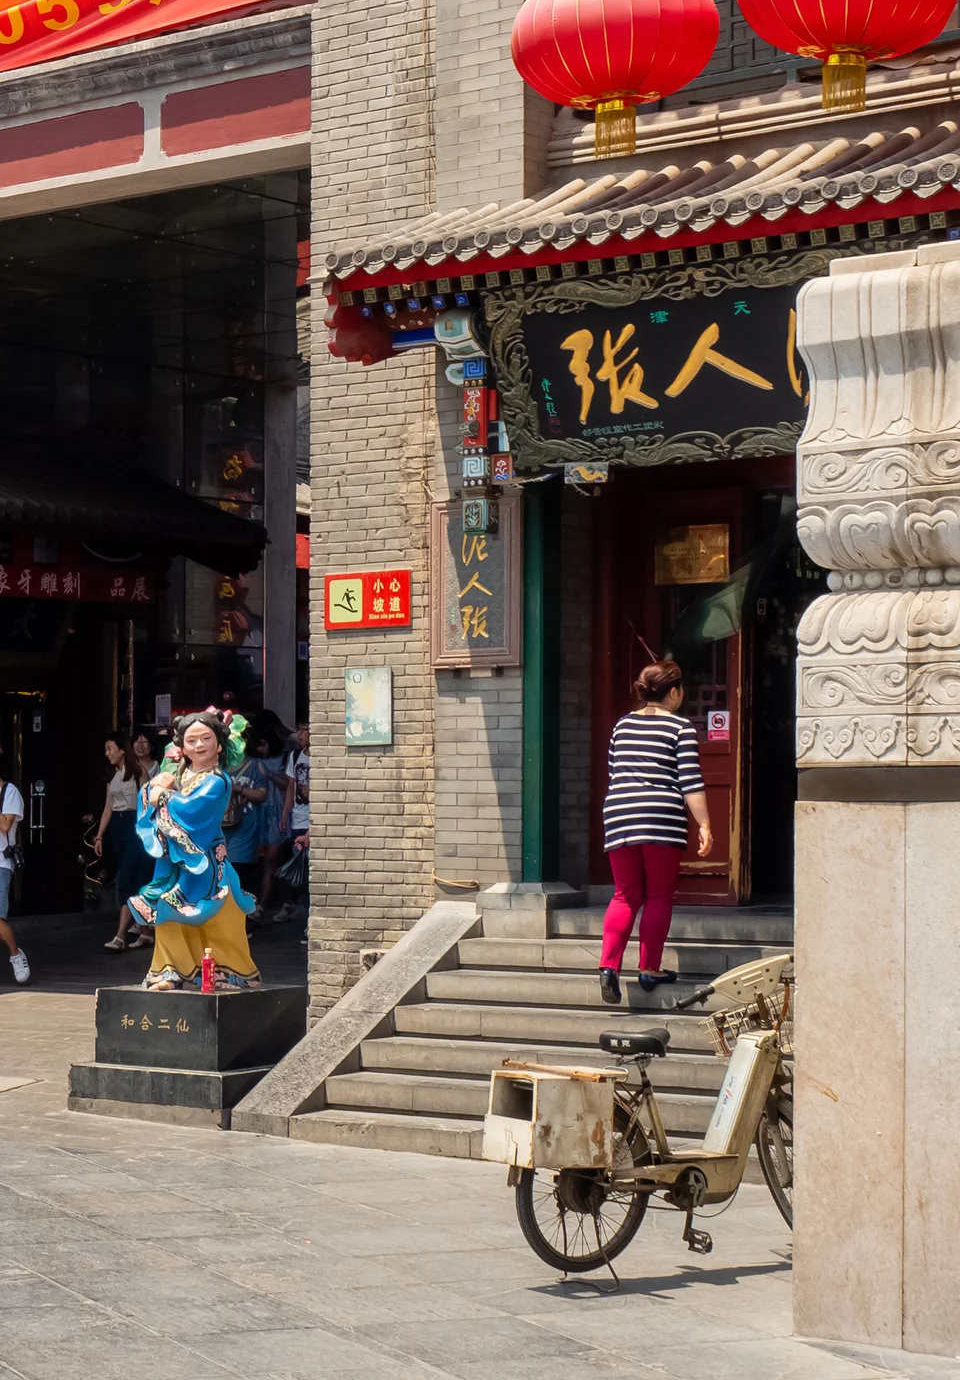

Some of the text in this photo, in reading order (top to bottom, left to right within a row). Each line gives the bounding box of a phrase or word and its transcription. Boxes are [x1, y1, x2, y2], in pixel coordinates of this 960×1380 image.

[560, 308, 810, 425] 人张
[110, 576, 151, 601] 品展
[373, 578, 401, 594] 小心
[457, 534, 493, 641] 泥人张
[373, 596, 401, 612] 坡道
[121, 1014, 190, 1033] 和合二仙
